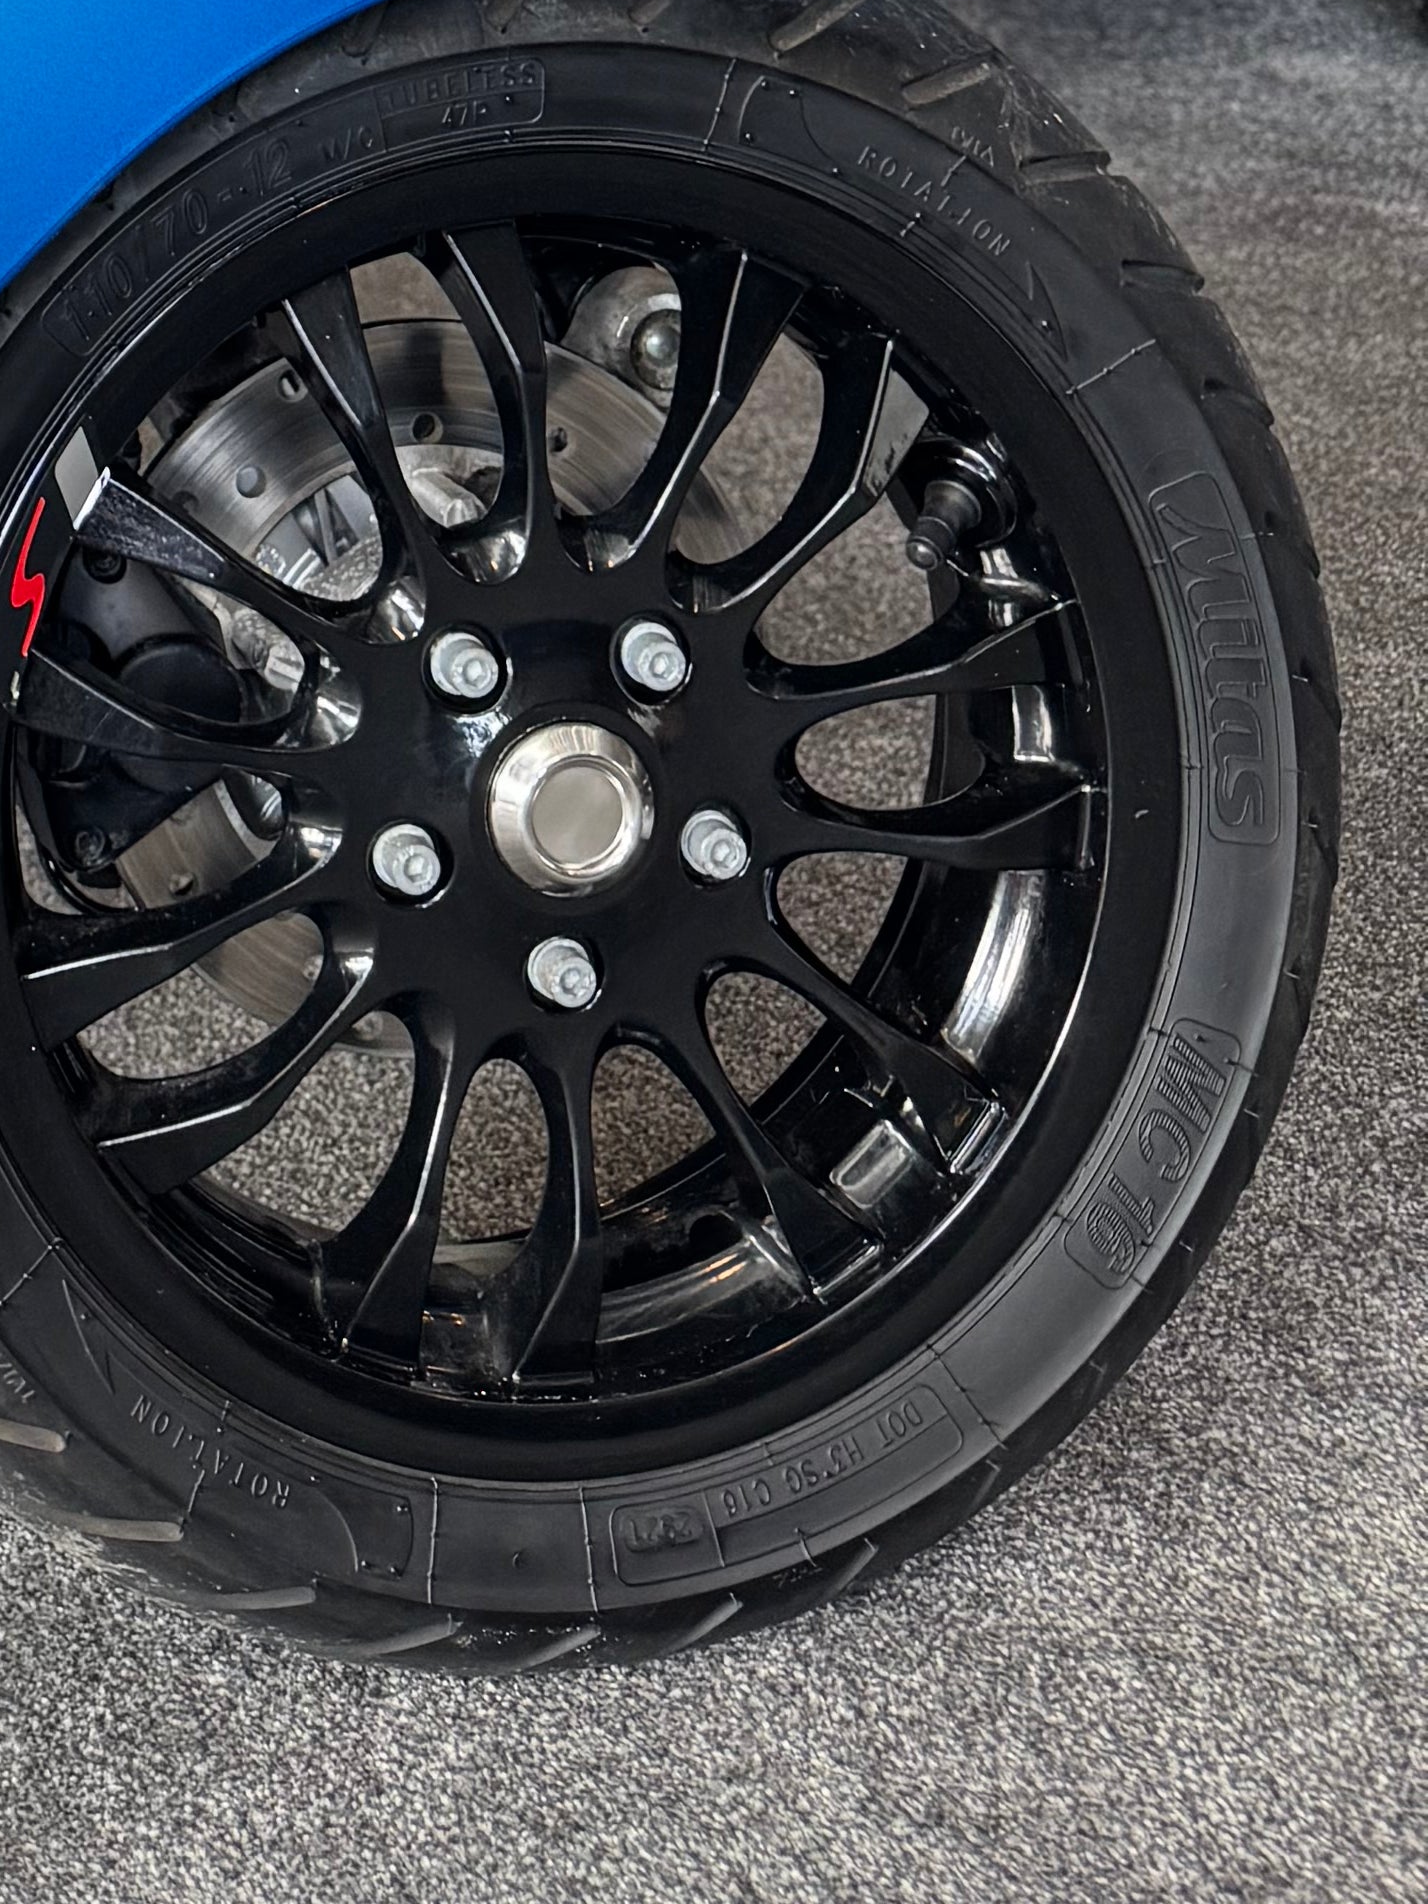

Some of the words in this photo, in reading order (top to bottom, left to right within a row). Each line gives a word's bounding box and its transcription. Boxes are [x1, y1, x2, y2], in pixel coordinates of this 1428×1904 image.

[376, 62, 536, 116] TUBELESS
[857, 145, 1011, 256] ROTATION
[1154, 503, 1267, 826] Mitas
[130, 1394, 291, 1509] ROTATION
[877, 1400, 924, 1448] DOT
